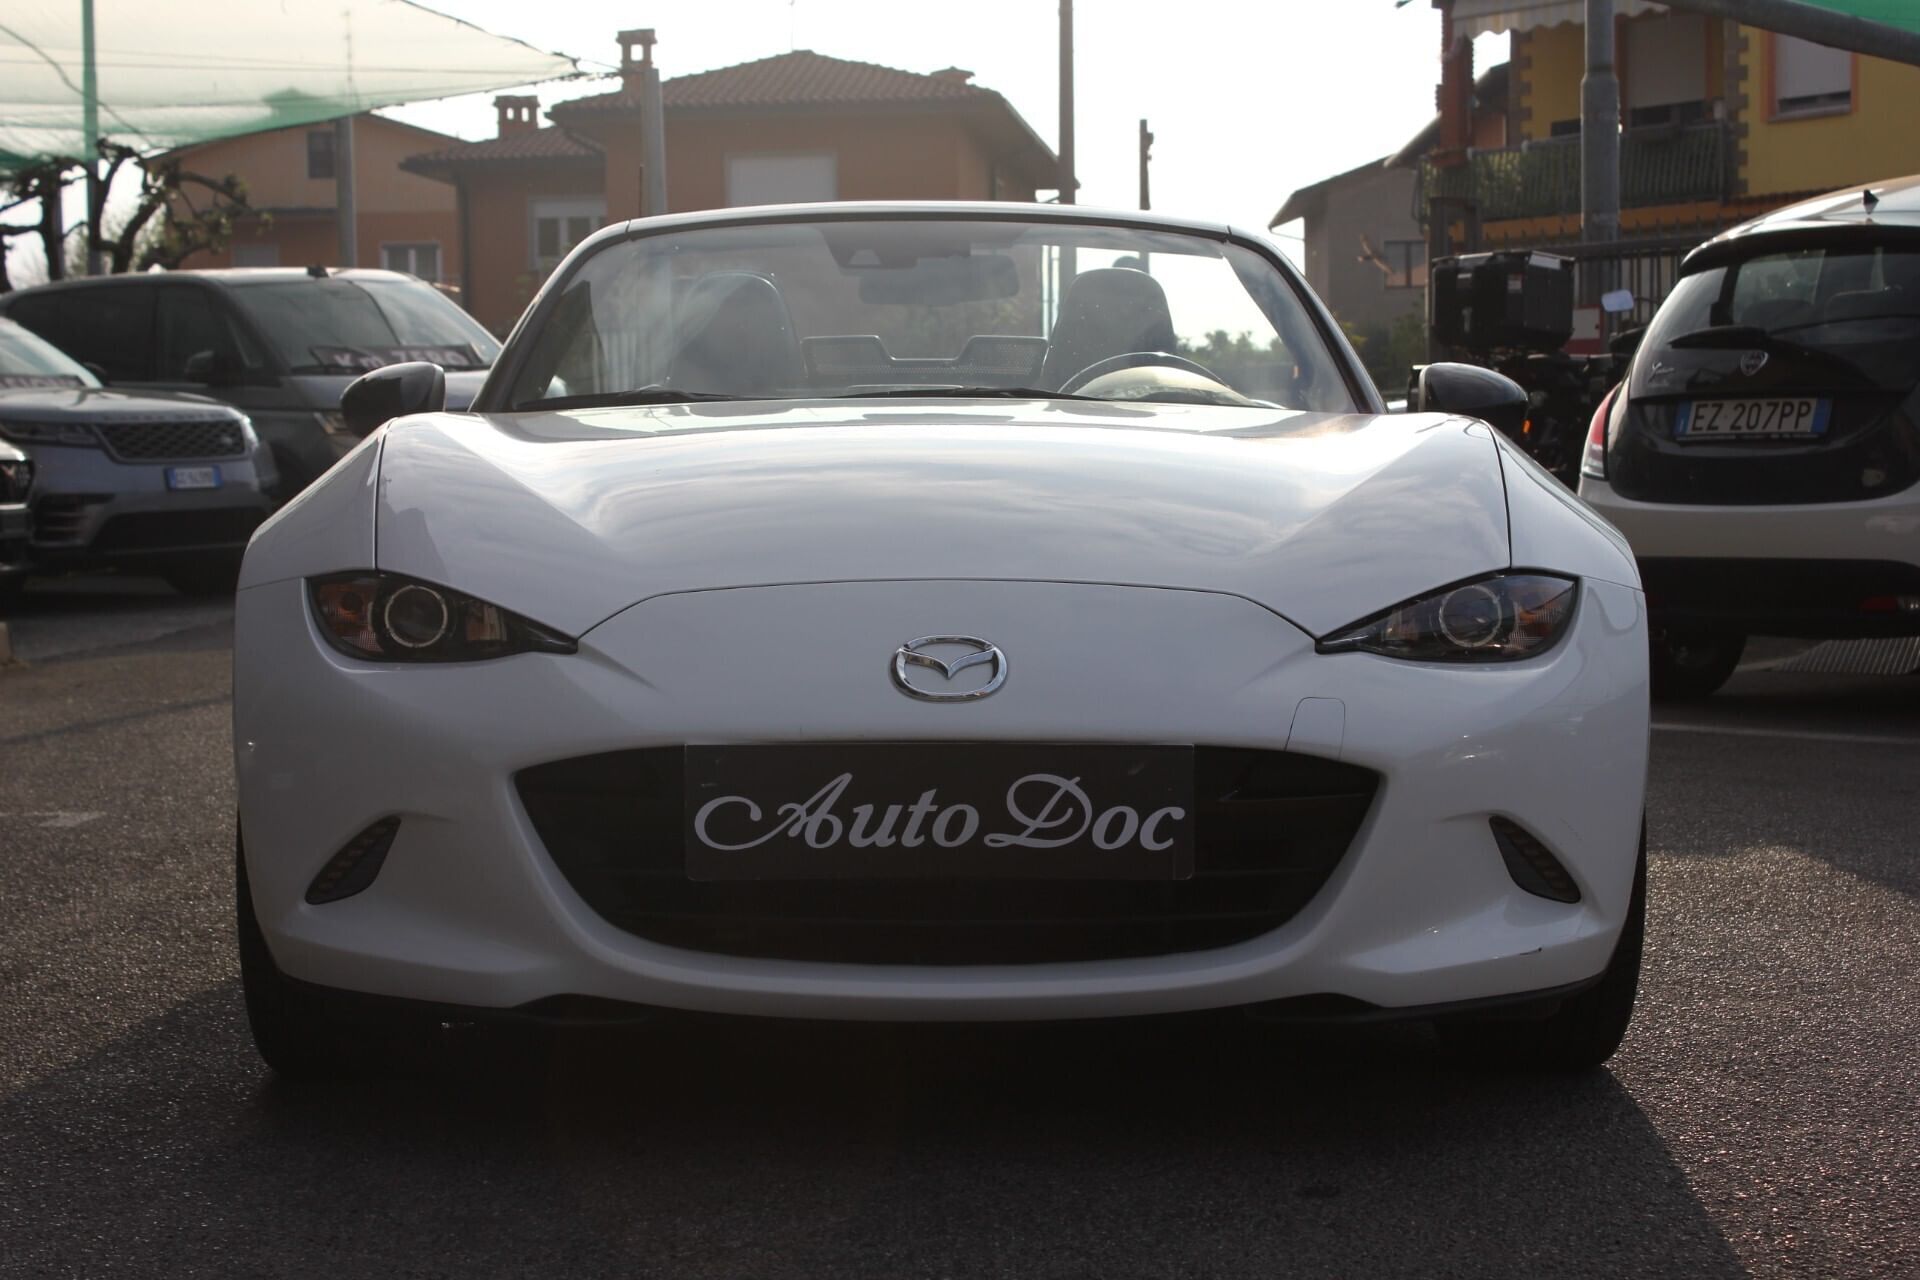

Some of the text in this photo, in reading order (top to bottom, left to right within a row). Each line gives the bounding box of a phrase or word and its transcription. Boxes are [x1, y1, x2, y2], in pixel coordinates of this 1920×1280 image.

[1692, 401, 1812, 431] EZ 207PP
[694, 772, 1185, 851] Auto Doc
